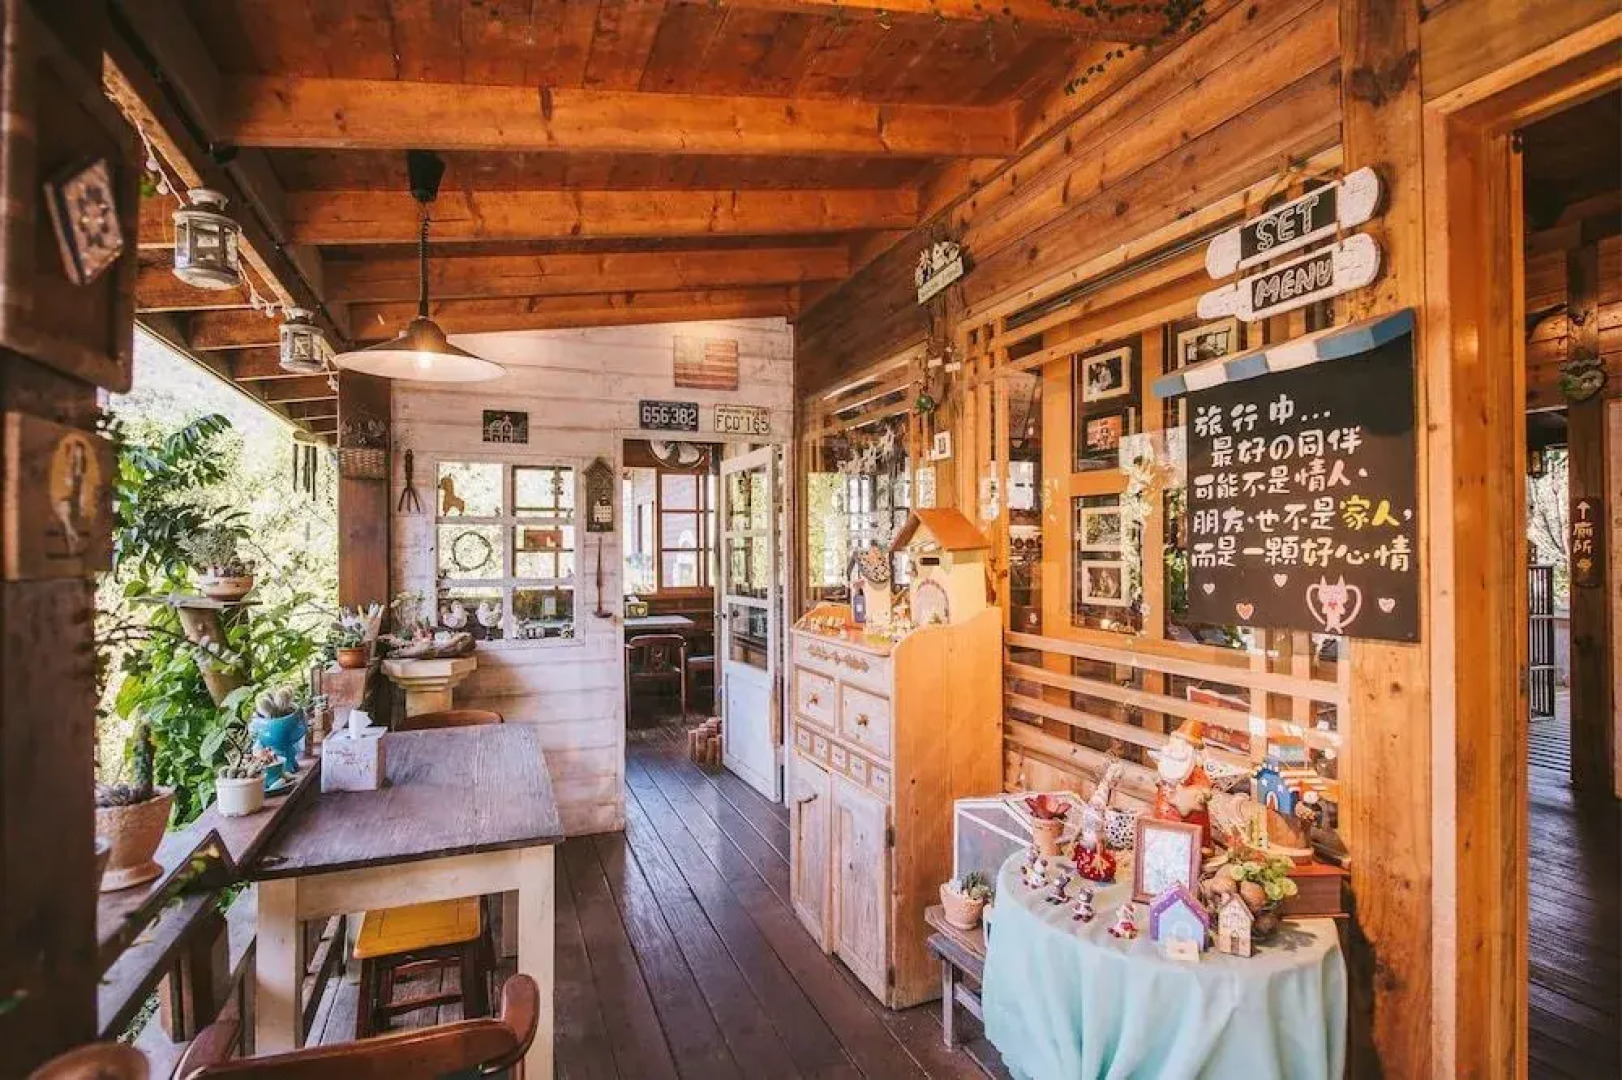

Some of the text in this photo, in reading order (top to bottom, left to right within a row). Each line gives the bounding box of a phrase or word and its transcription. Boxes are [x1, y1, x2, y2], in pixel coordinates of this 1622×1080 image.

[1255, 195, 1320, 251] SET
[1253, 257, 1334, 308] MENU
[1211, 426, 1363, 468] 最好の同伴
[1191, 534, 1412, 572] 而是一顆好心情
